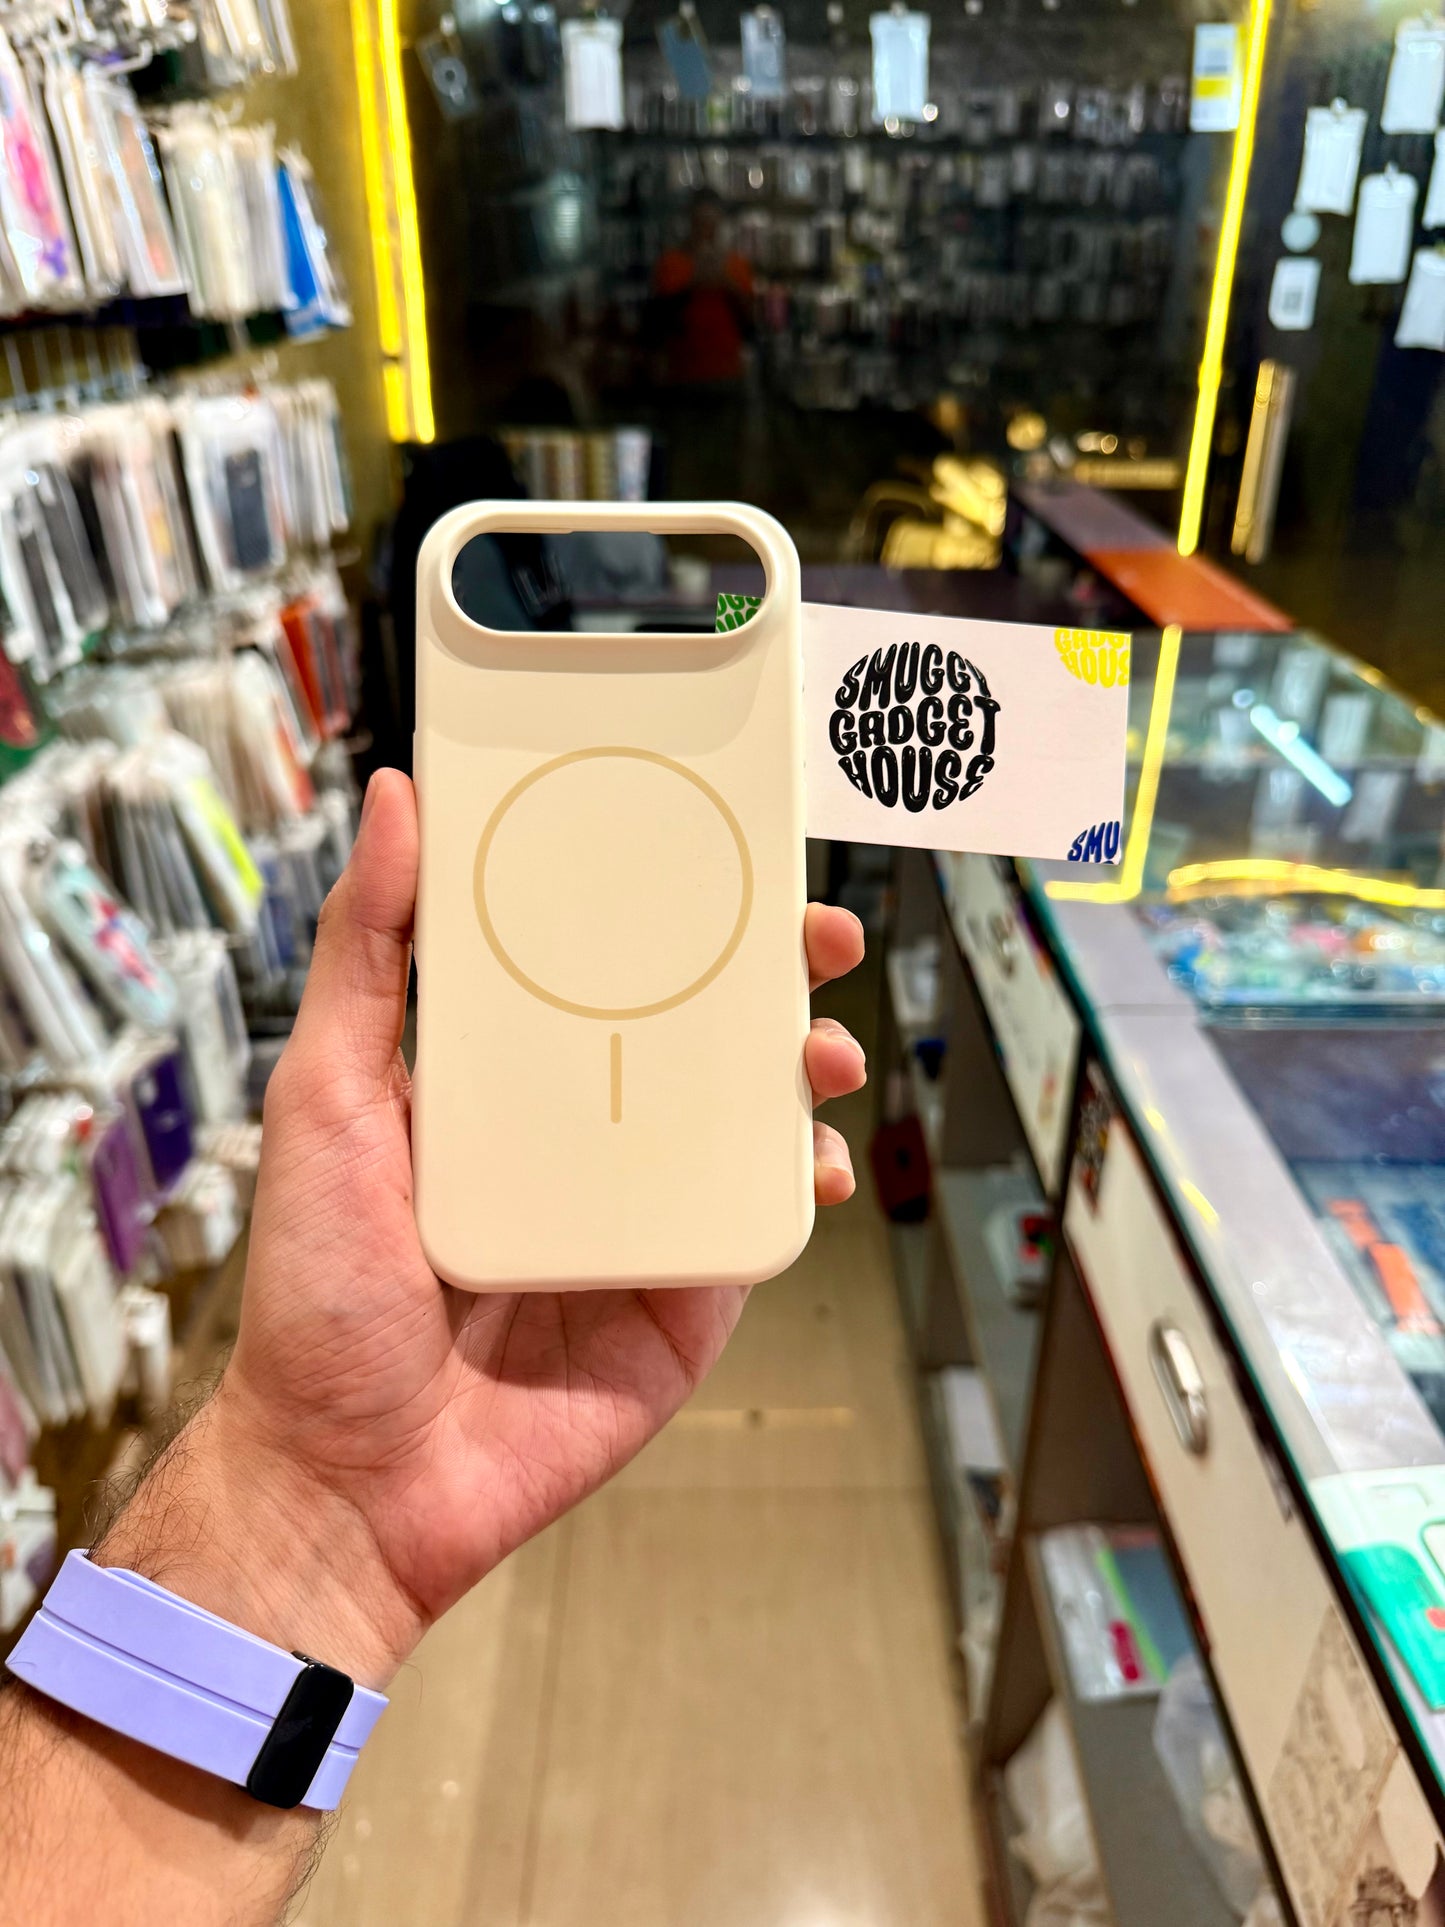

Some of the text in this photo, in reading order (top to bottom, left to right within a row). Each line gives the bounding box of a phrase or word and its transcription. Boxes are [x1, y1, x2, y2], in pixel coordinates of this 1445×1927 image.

[835, 642, 992, 711] SMUGGY
[829, 694, 1001, 756] GADGET
[838, 745, 995, 813] HOUSE
